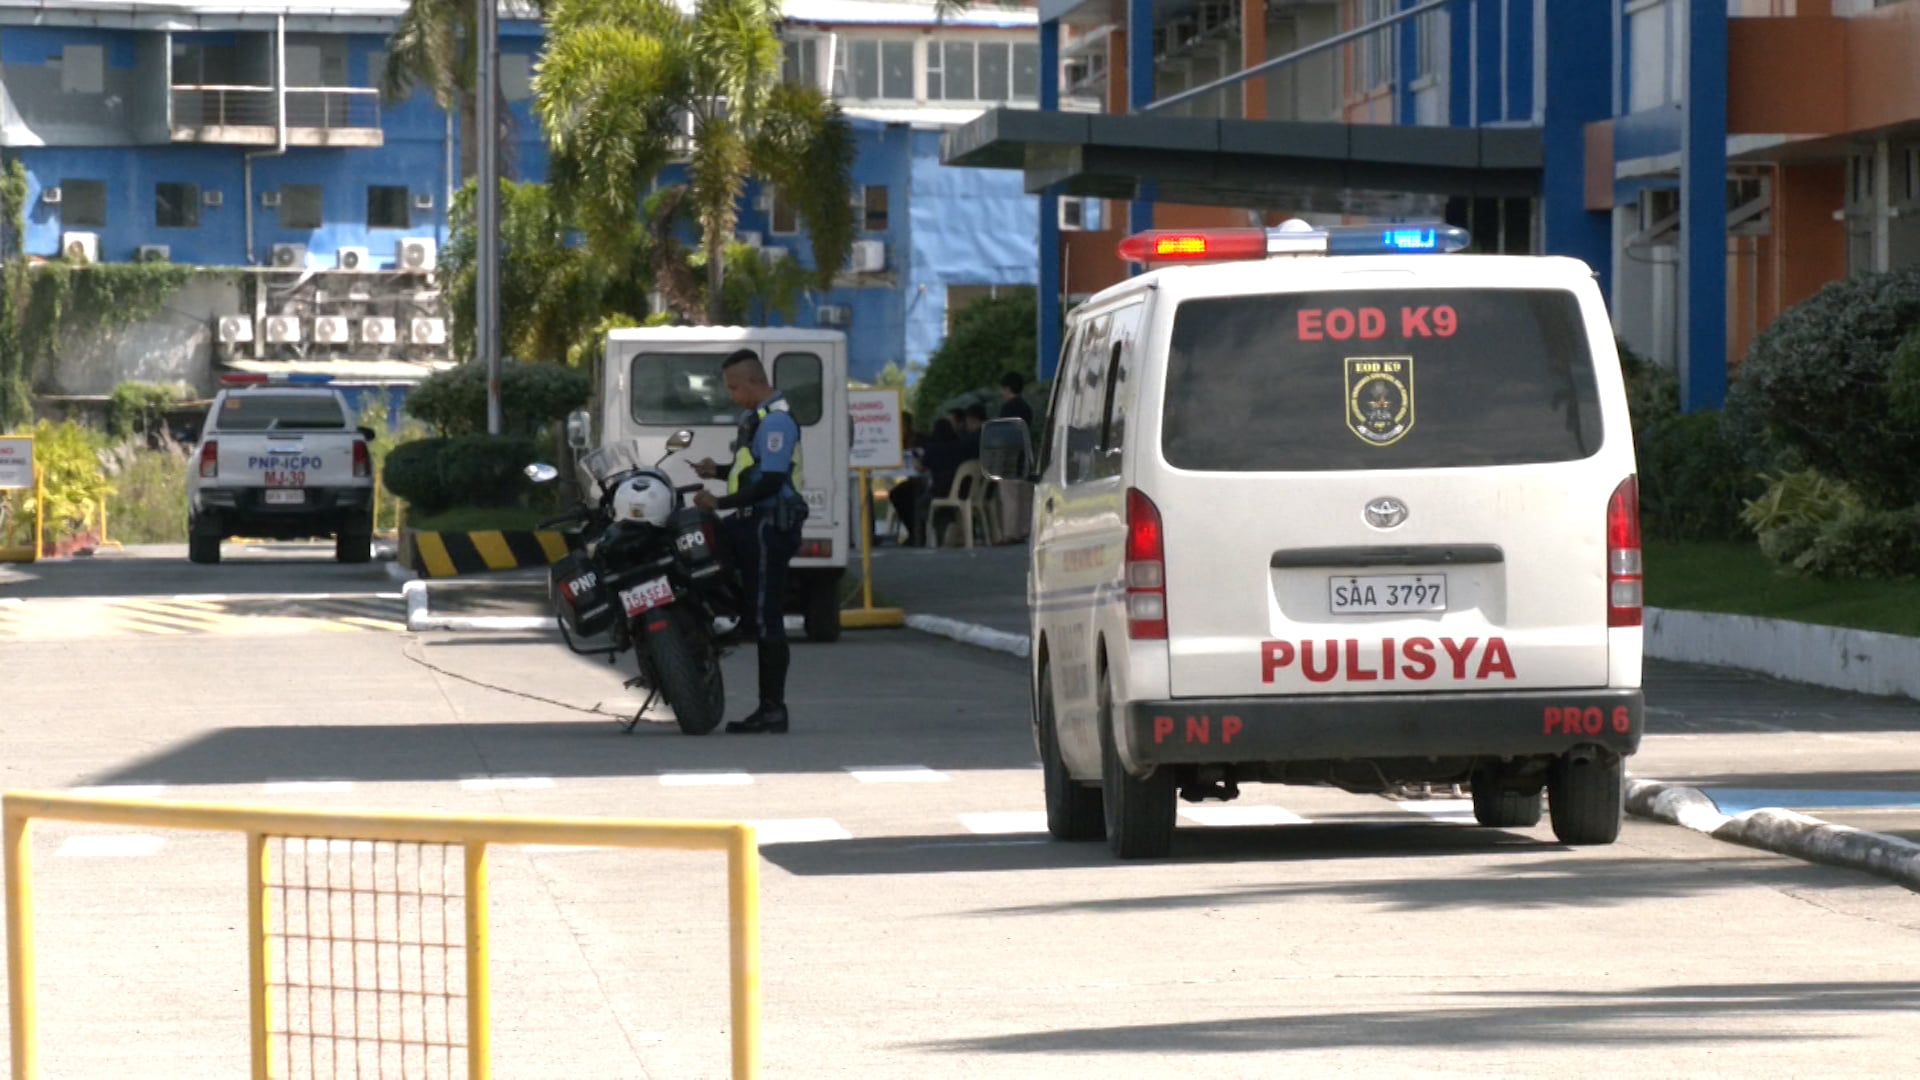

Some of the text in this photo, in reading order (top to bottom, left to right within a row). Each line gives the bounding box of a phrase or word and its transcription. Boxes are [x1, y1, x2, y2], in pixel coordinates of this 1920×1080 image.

[1297, 305, 1459, 341] EOD K9
[1355, 361, 1402, 373] EOD K9
[247, 455, 322, 470] PNP-ICPO
[568, 571, 598, 597] PNP
[1335, 583, 1441, 606] SAA 3797
[1261, 636, 1517, 684] PULISYA
[1543, 704, 1631, 737] PRO 6
